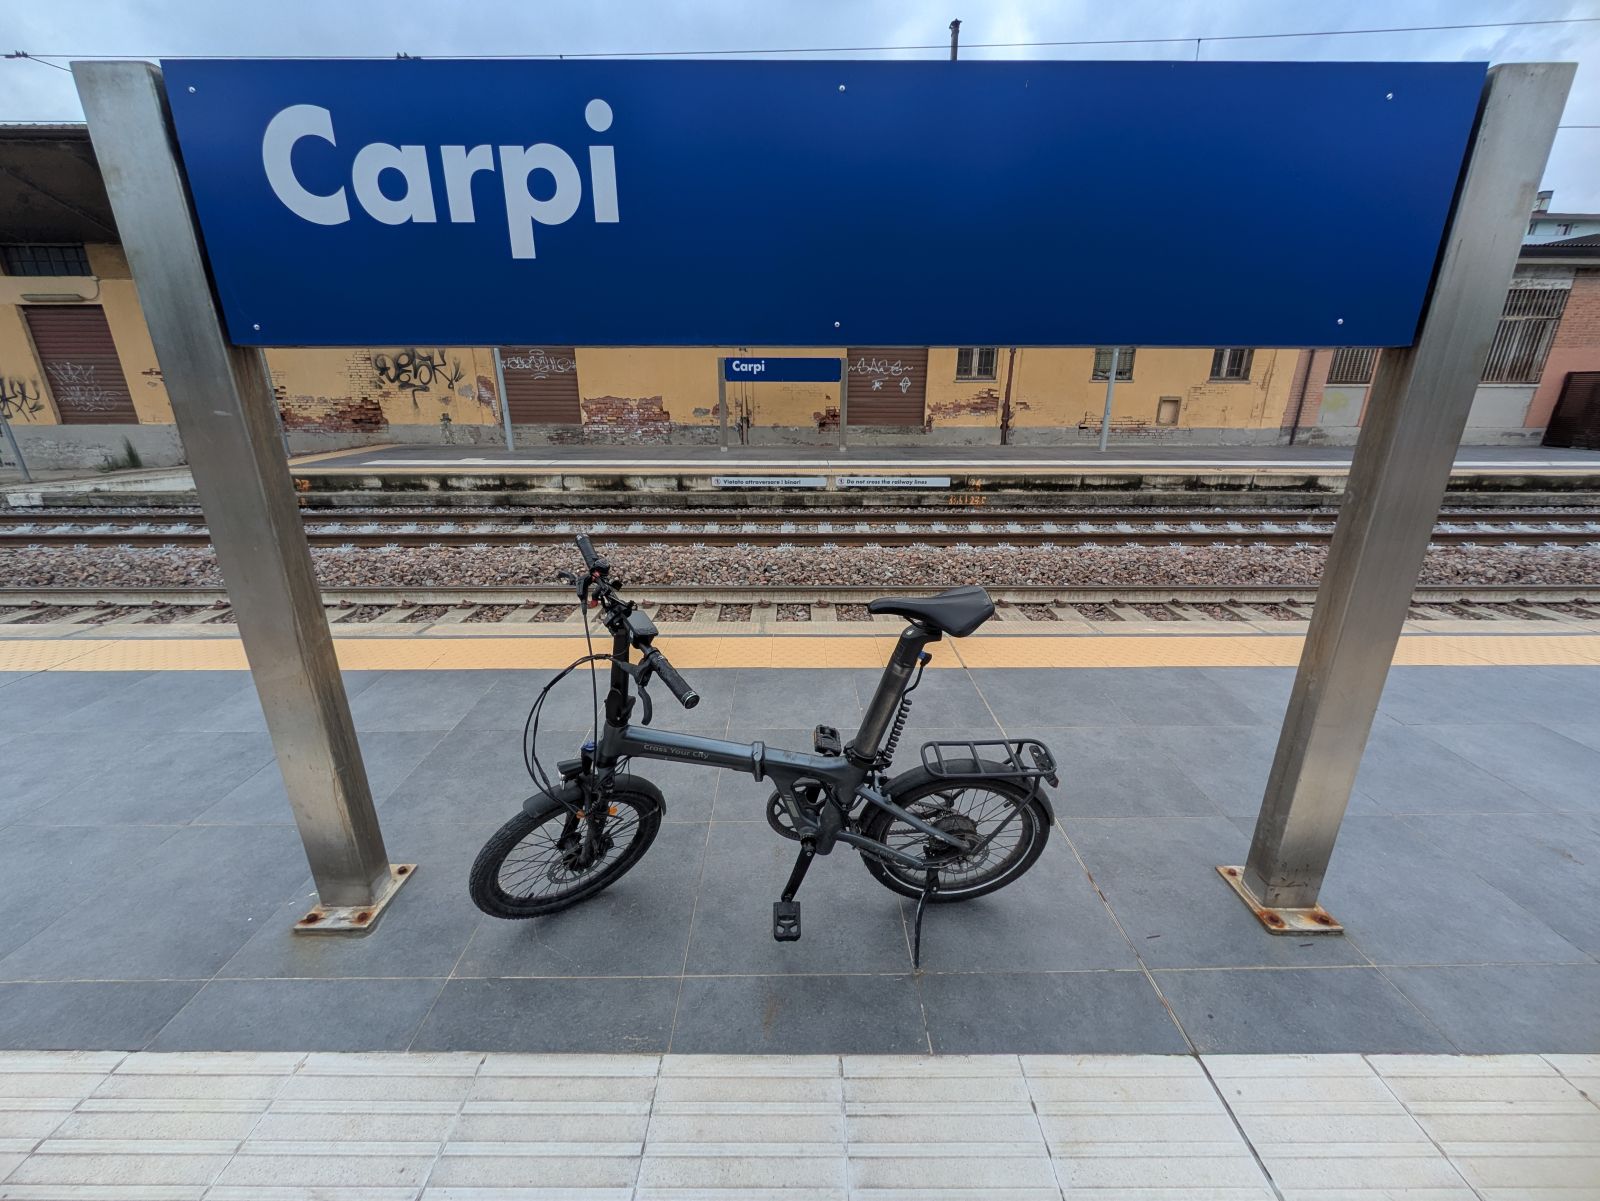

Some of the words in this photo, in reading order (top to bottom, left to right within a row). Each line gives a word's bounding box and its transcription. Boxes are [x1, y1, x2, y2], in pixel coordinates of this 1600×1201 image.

[262, 98, 620, 259] Carpi
[732, 360, 765, 374] Carpi
[643, 743, 667, 753] Cross
[670, 747, 690, 756] Your
[692, 751, 709, 760] City
